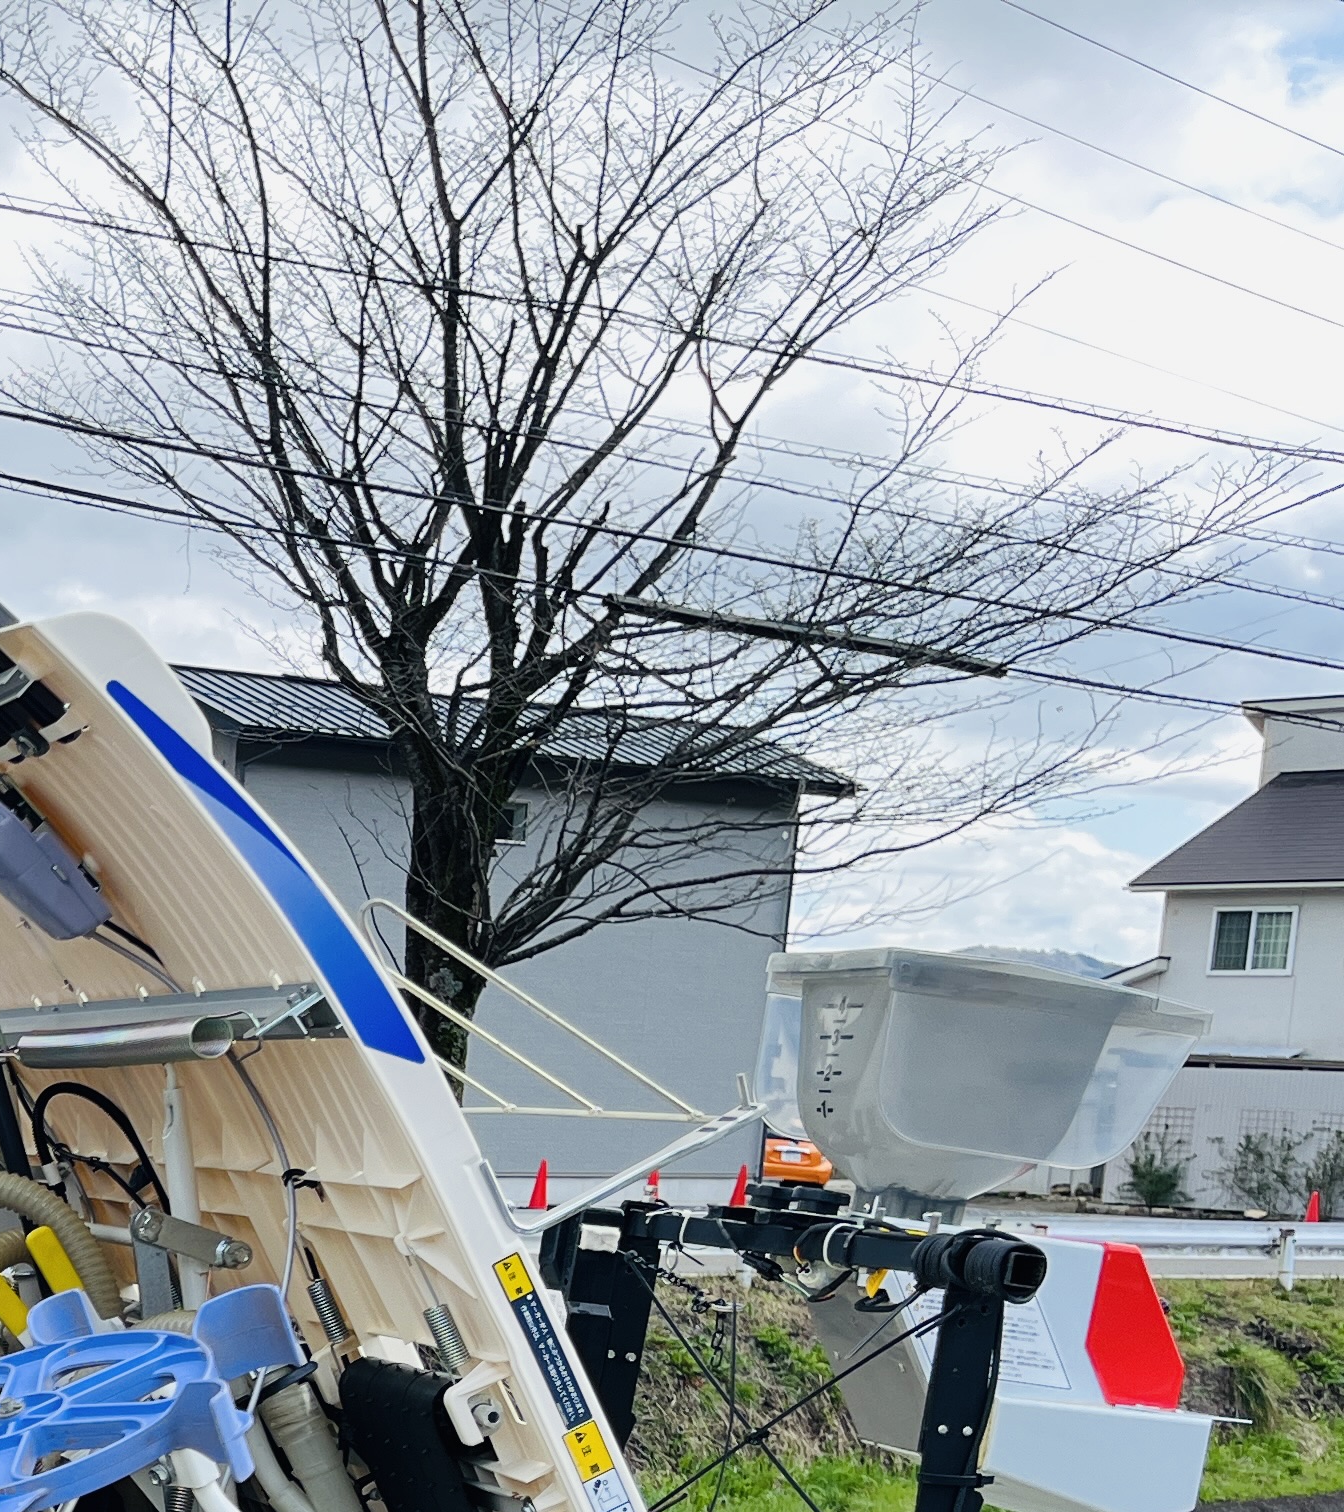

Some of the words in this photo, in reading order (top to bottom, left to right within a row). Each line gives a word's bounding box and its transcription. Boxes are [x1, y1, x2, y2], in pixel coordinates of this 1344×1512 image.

[832, 1028, 840, 1046] 3
[824, 1063, 833, 1081] 2
[821, 1100, 827, 1118] 1
